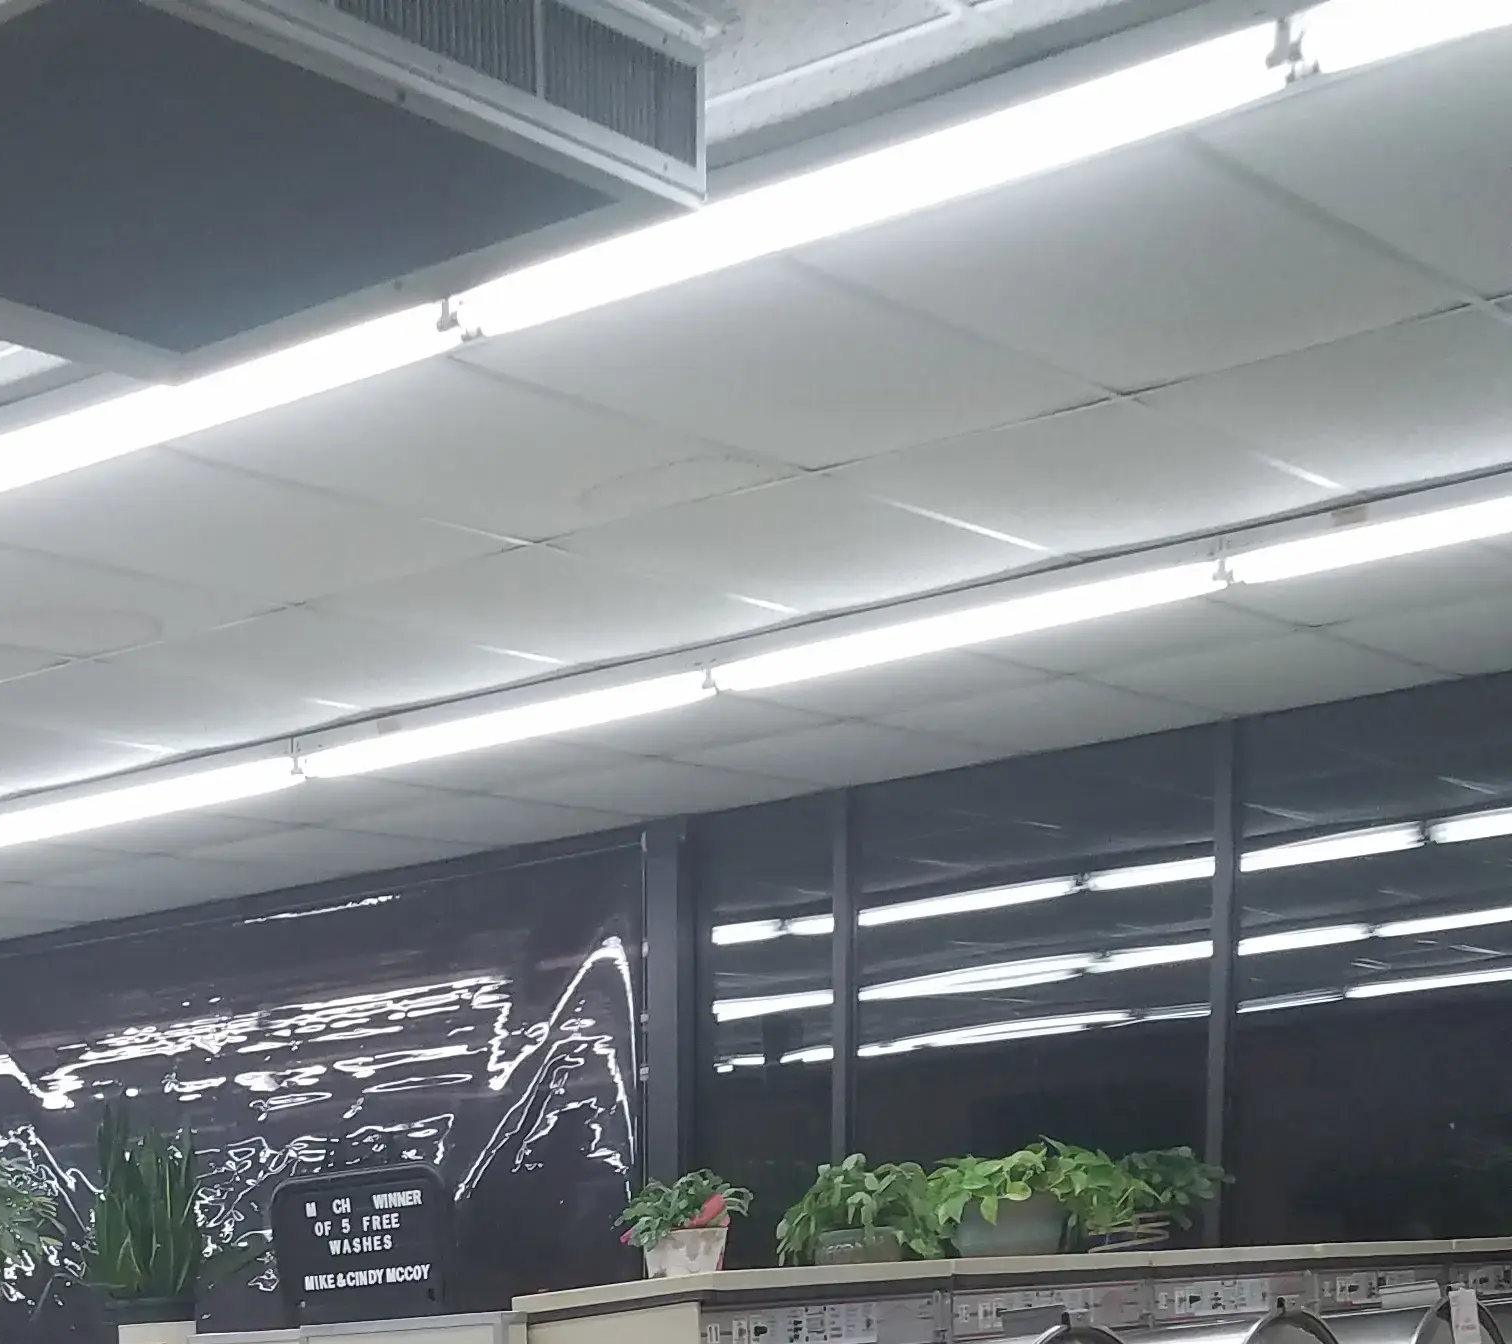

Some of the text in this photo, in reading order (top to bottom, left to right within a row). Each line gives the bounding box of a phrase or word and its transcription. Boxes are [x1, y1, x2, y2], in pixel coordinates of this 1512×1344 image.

[372, 1189, 423, 1210] WINNER
[314, 1212, 400, 1237] OF 5 FREE
[328, 1234, 393, 1255] WASHES
[385, 1263, 430, 1283] MCCOY
